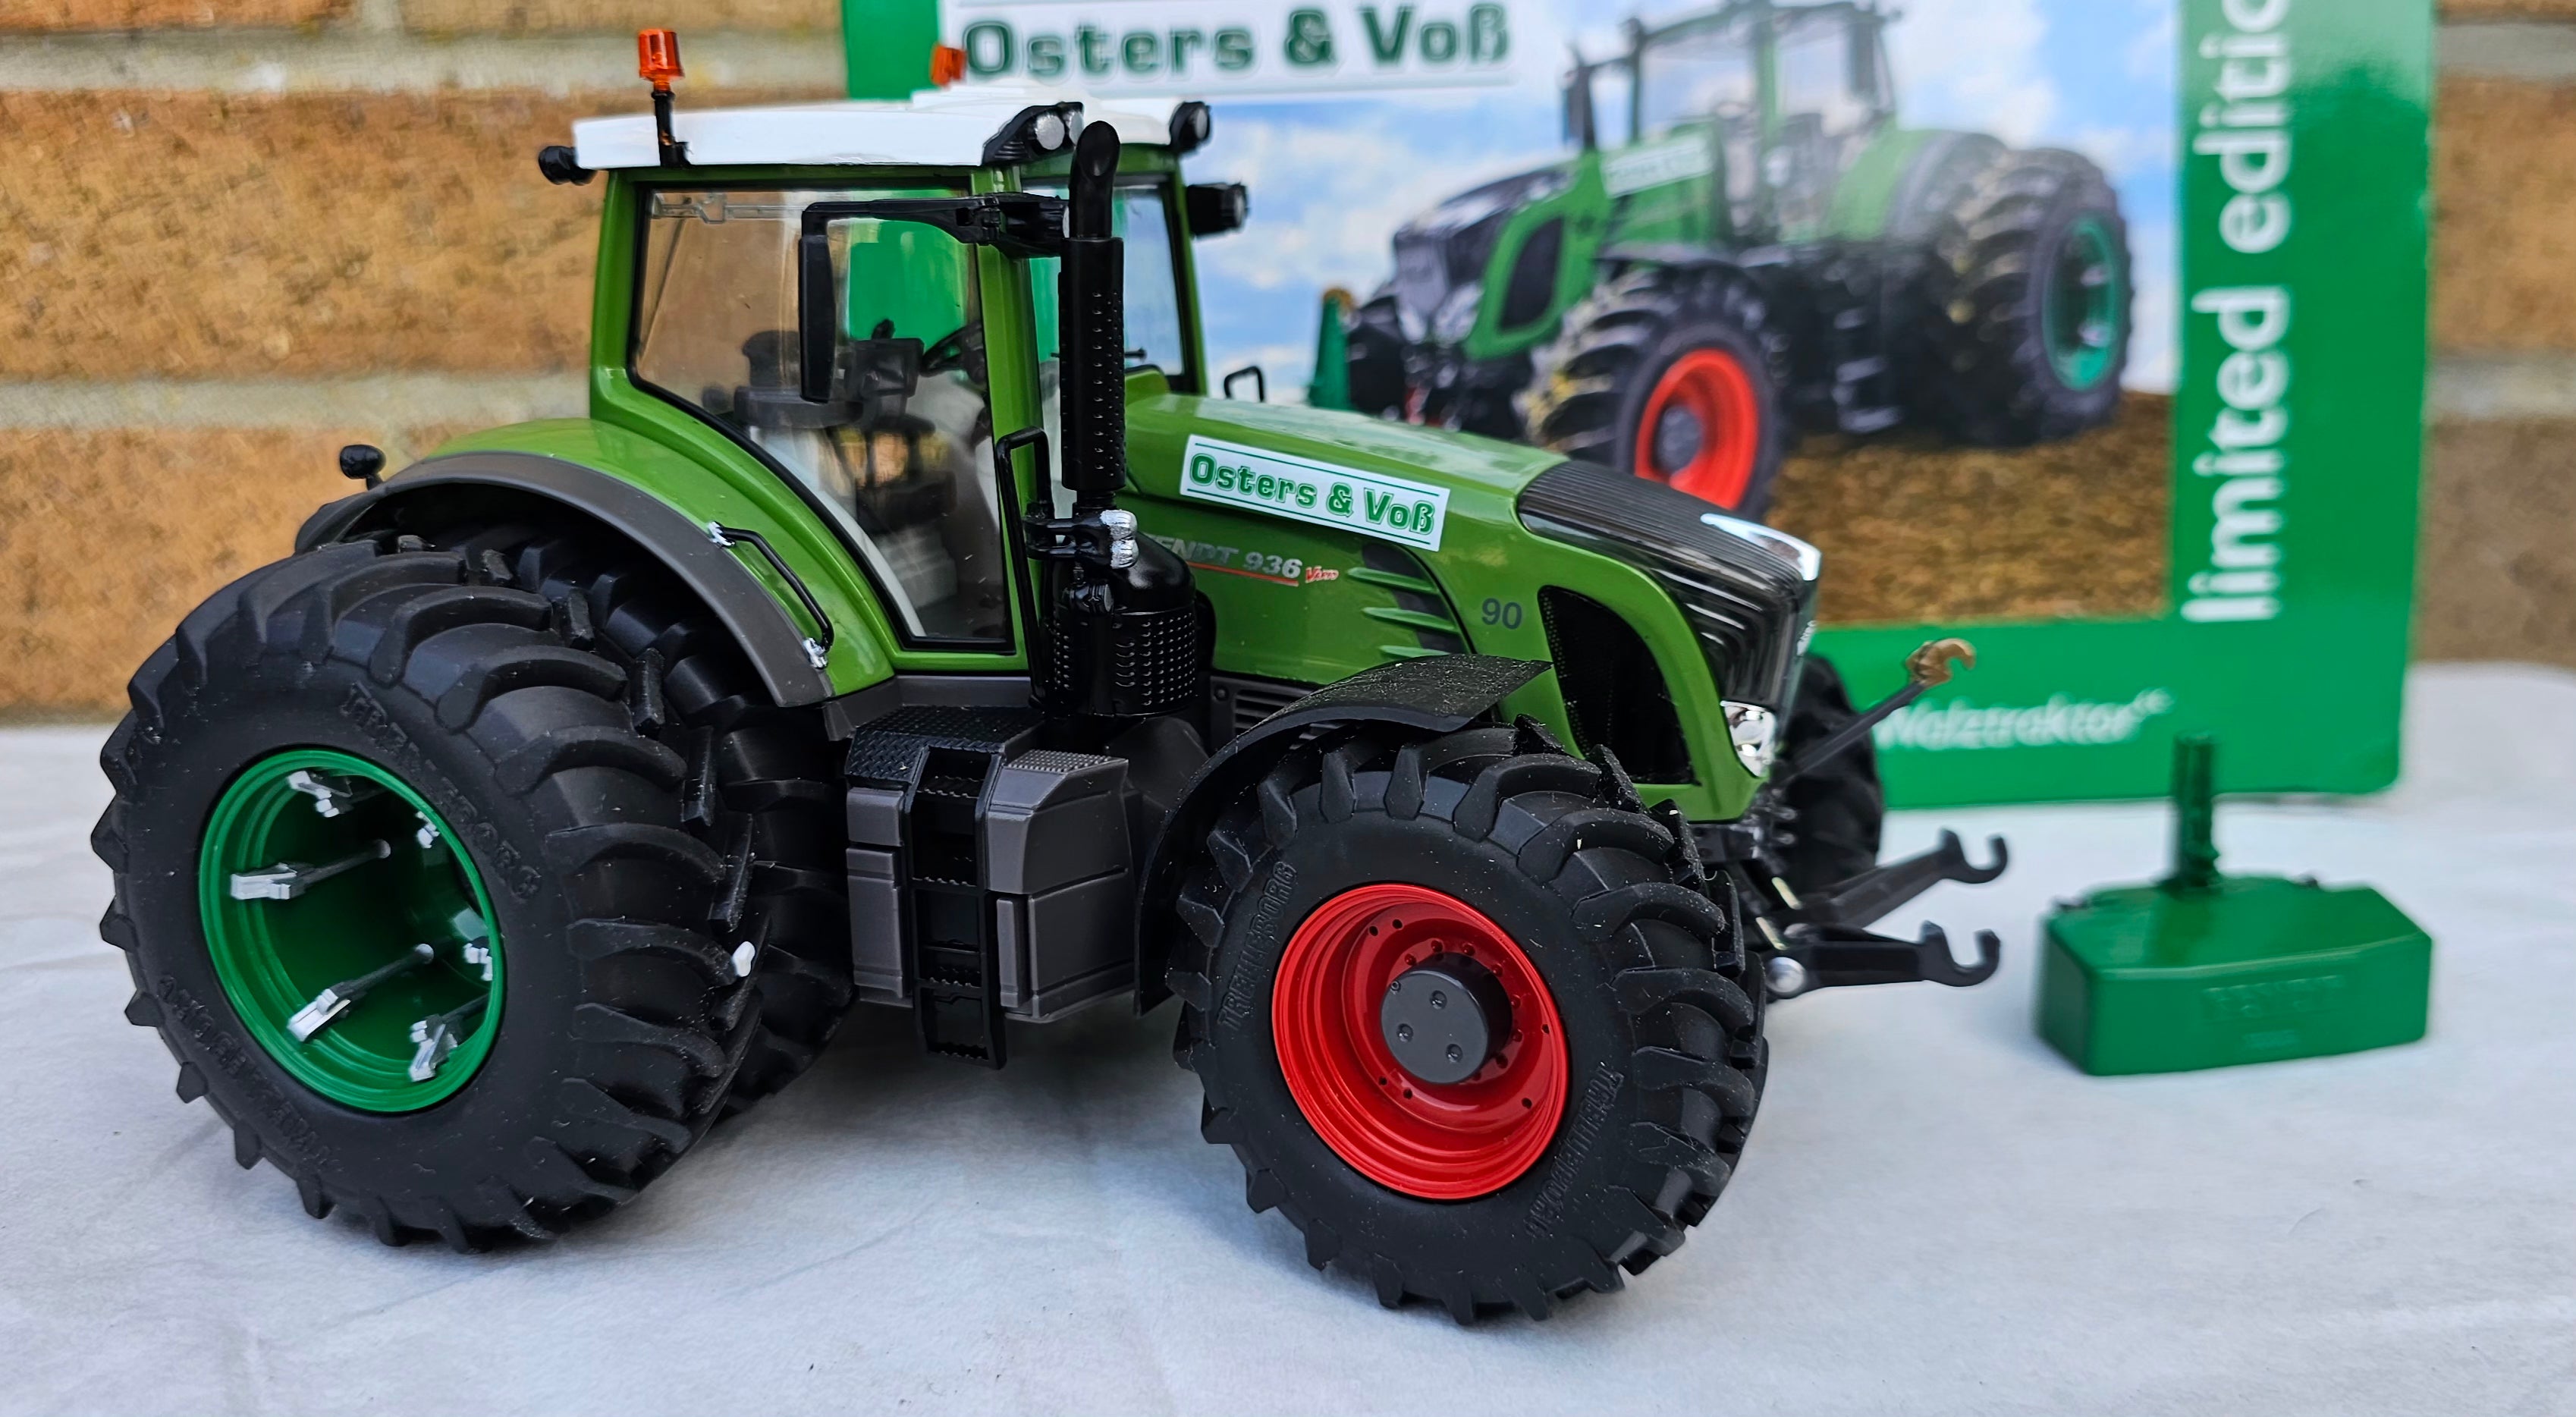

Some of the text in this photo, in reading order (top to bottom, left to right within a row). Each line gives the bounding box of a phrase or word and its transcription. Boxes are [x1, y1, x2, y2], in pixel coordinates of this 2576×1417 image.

[962, 2, 1509, 76] Osters & Voß
[2180, 285, 2290, 623] limited
[1189, 453, 1436, 536] Osters & Voß
[1243, 551, 1303, 579] 936
[1481, 597, 1522, 630] 90
[1217, 860, 1298, 1032] TRELLEBORG
